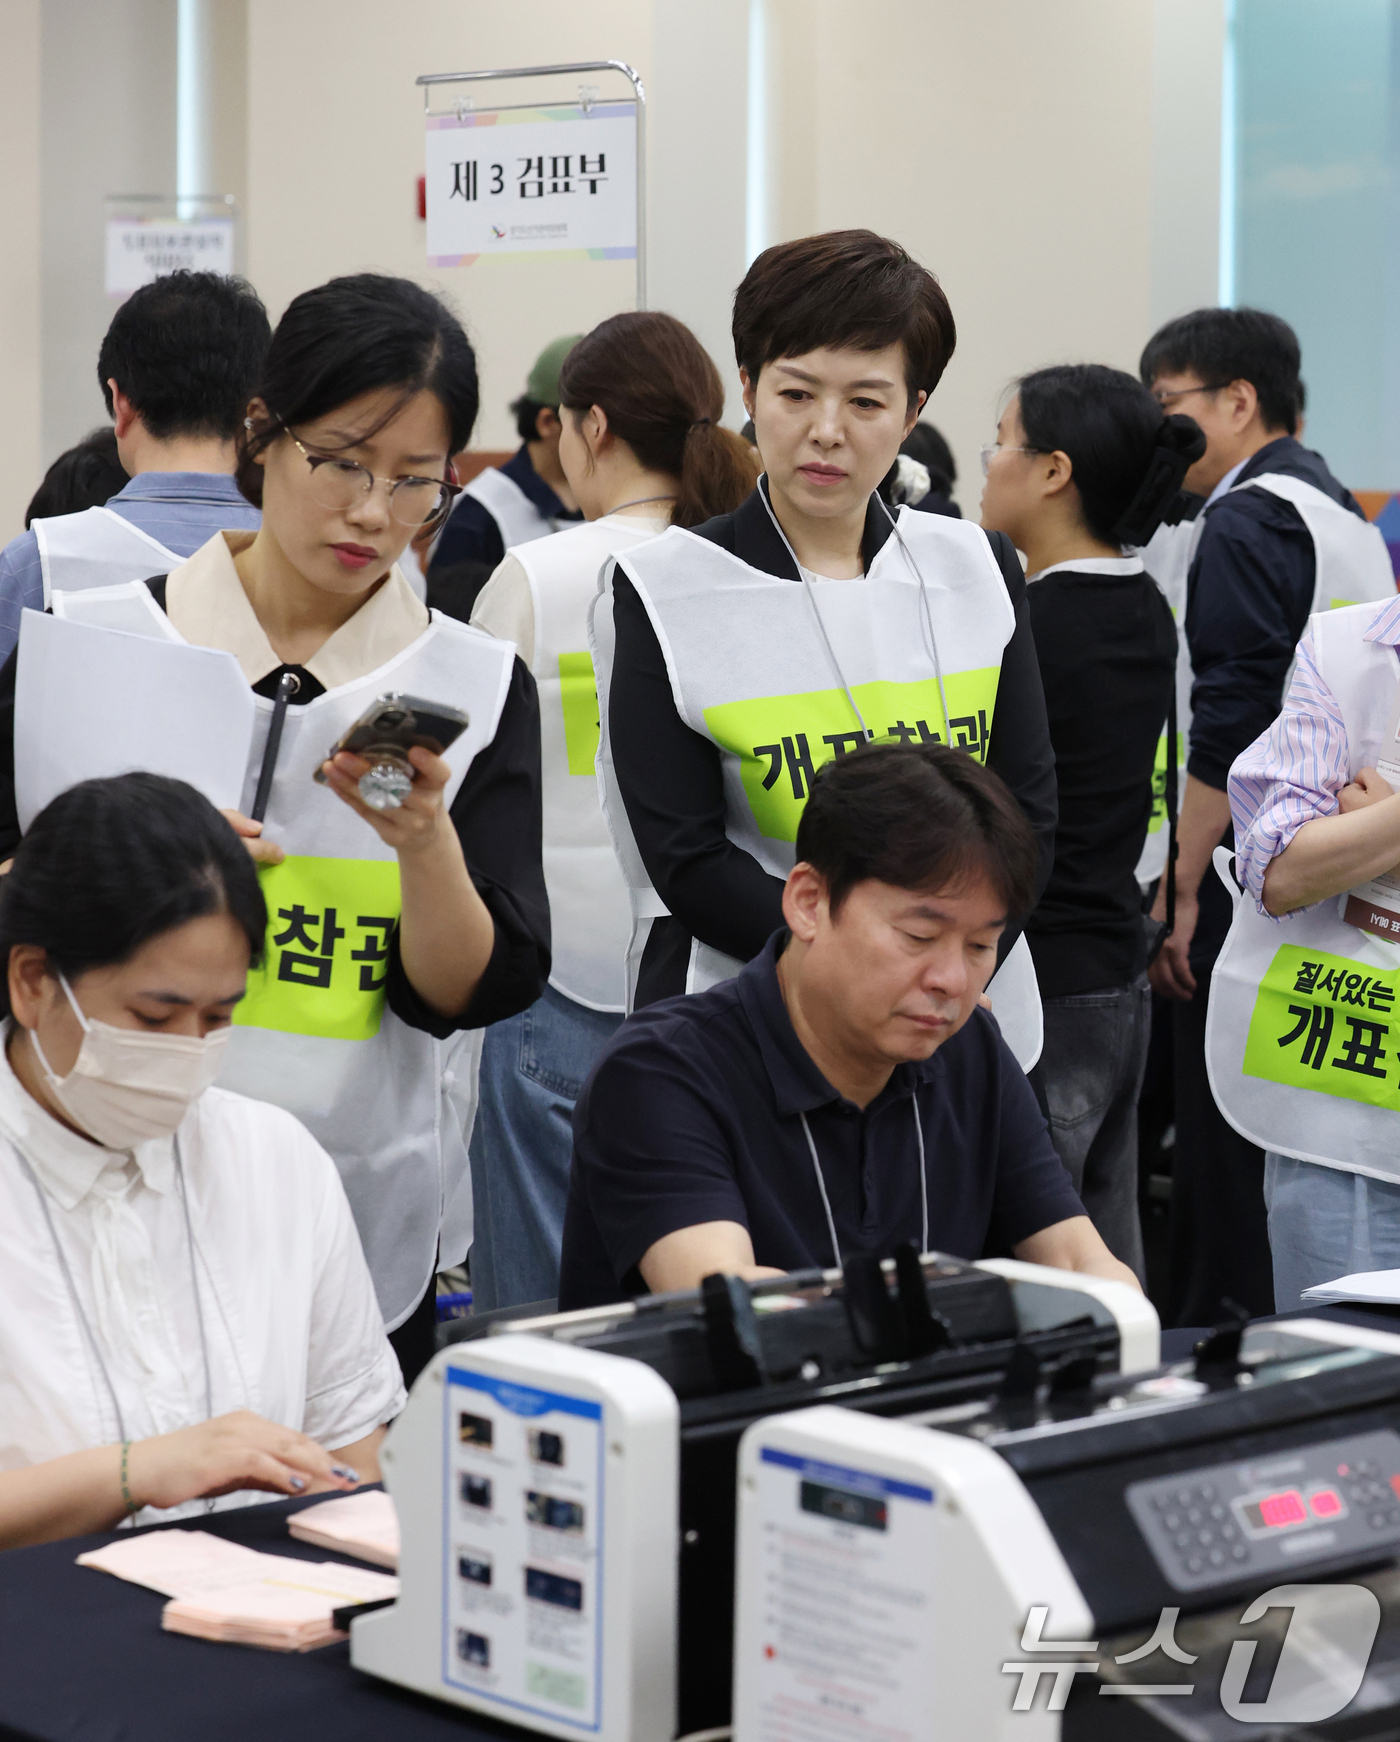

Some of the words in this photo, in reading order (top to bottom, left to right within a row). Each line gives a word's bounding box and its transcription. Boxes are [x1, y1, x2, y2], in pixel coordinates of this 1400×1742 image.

[449, 160, 478, 201] 제
[489, 163, 505, 195] 3
[516, 153, 609, 199] 검표부
[1370, 912, 1390, 929] 예시
[1293, 961, 1395, 1013] 질서있는
[1277, 1004, 1400, 1090] 개표
